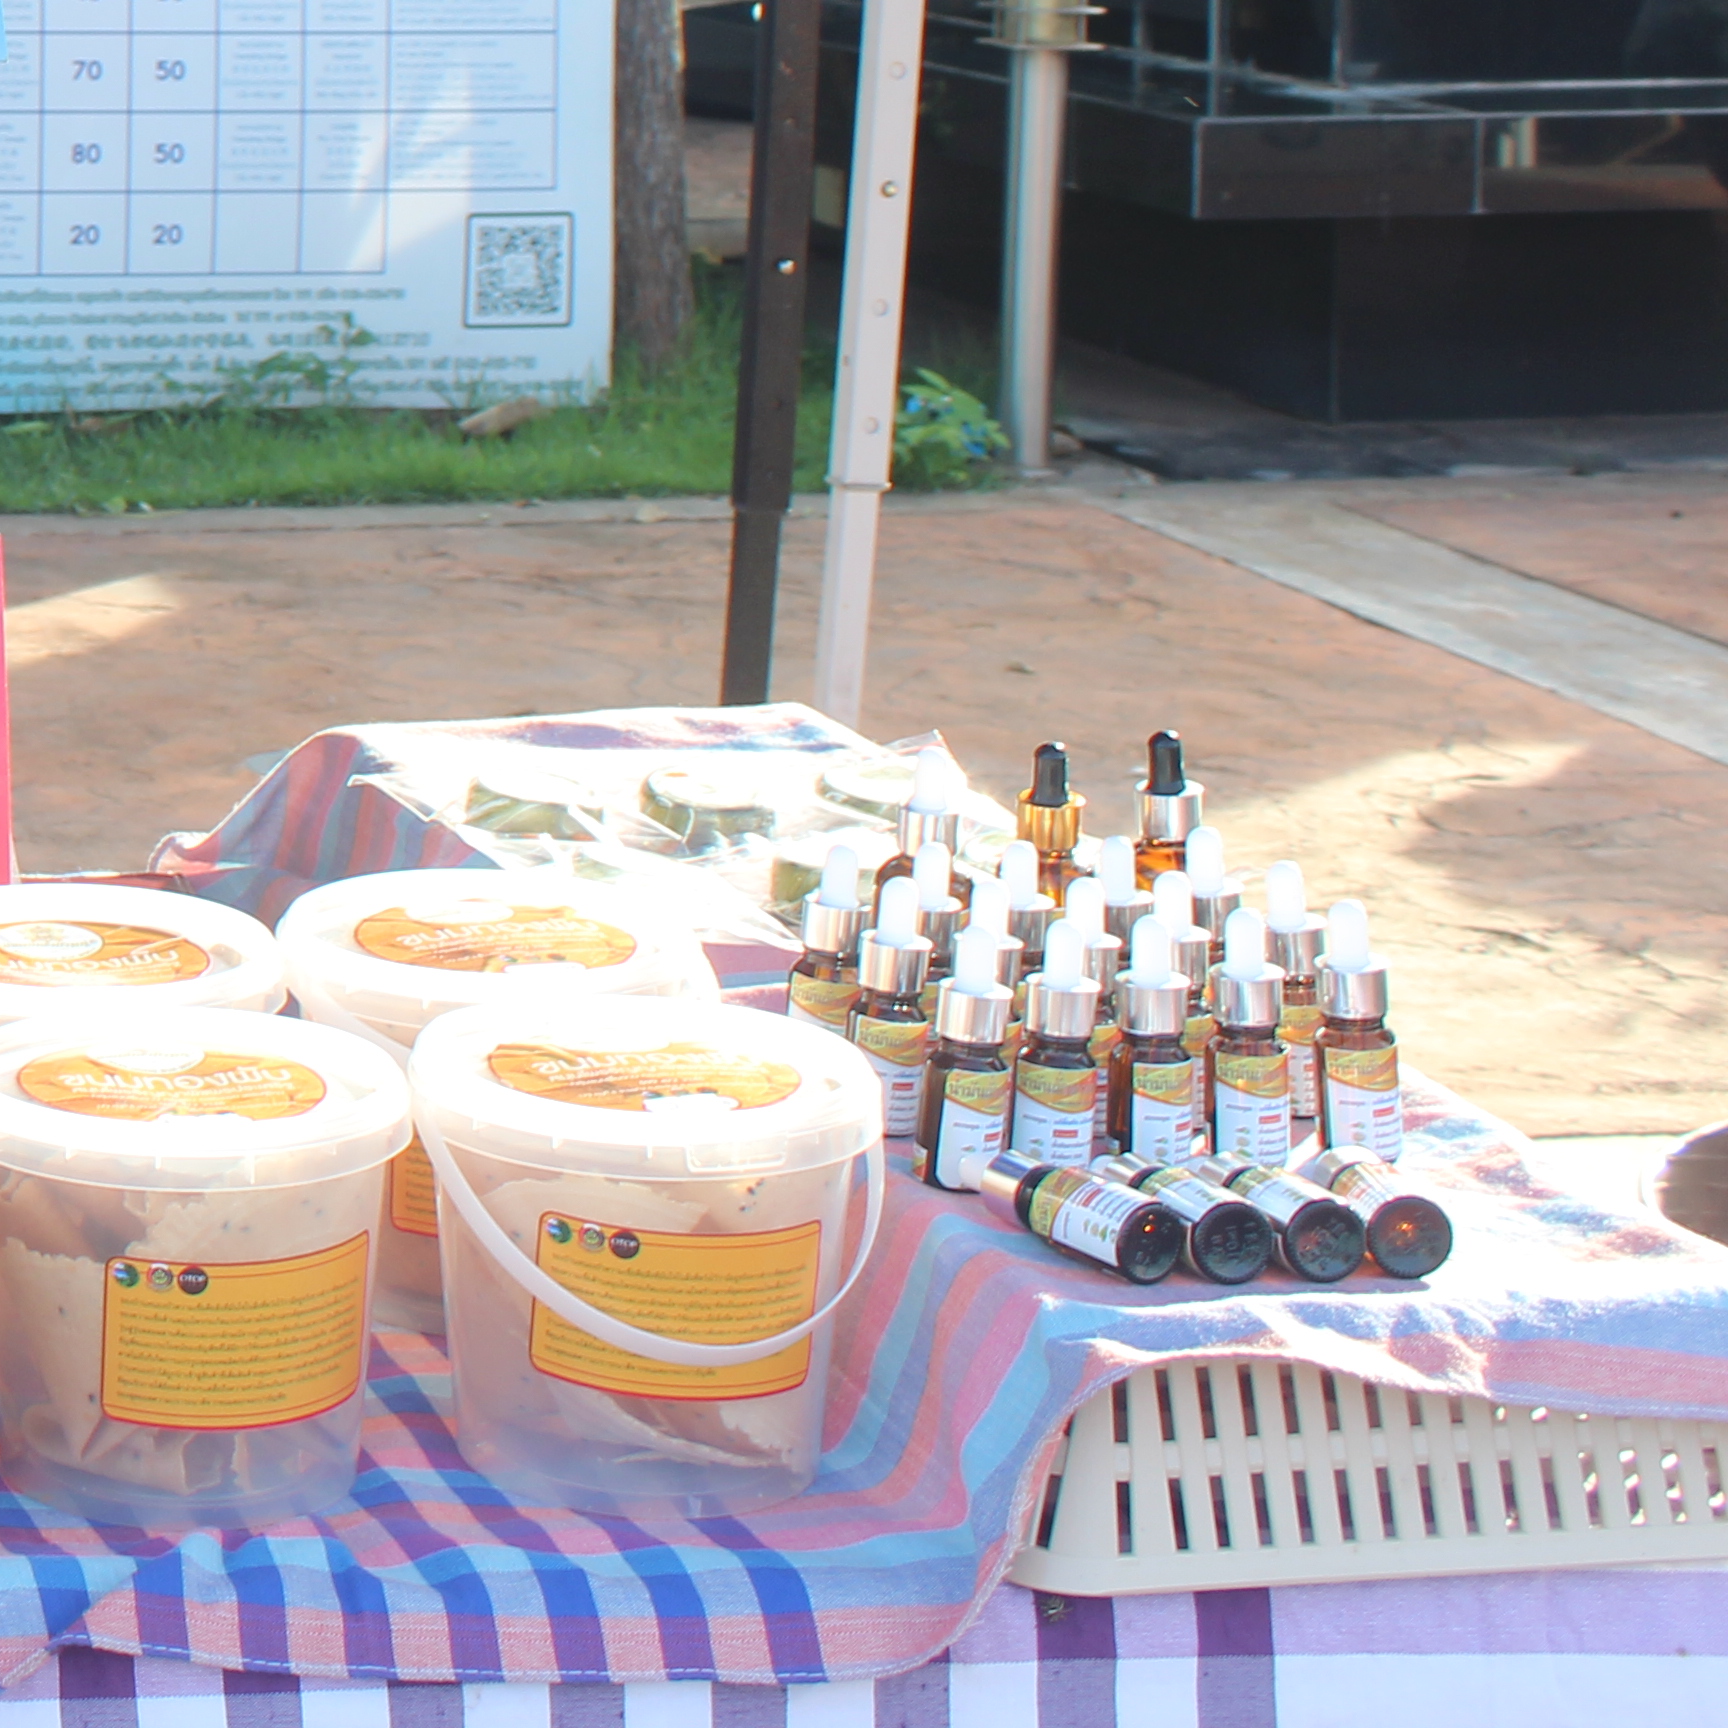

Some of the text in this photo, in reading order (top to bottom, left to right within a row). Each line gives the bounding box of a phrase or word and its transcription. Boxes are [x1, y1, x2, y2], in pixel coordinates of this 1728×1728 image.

[72, 58, 187, 82] 70 50
[70, 142, 186, 166] 80 50
[69, 223, 184, 247] 20 20
